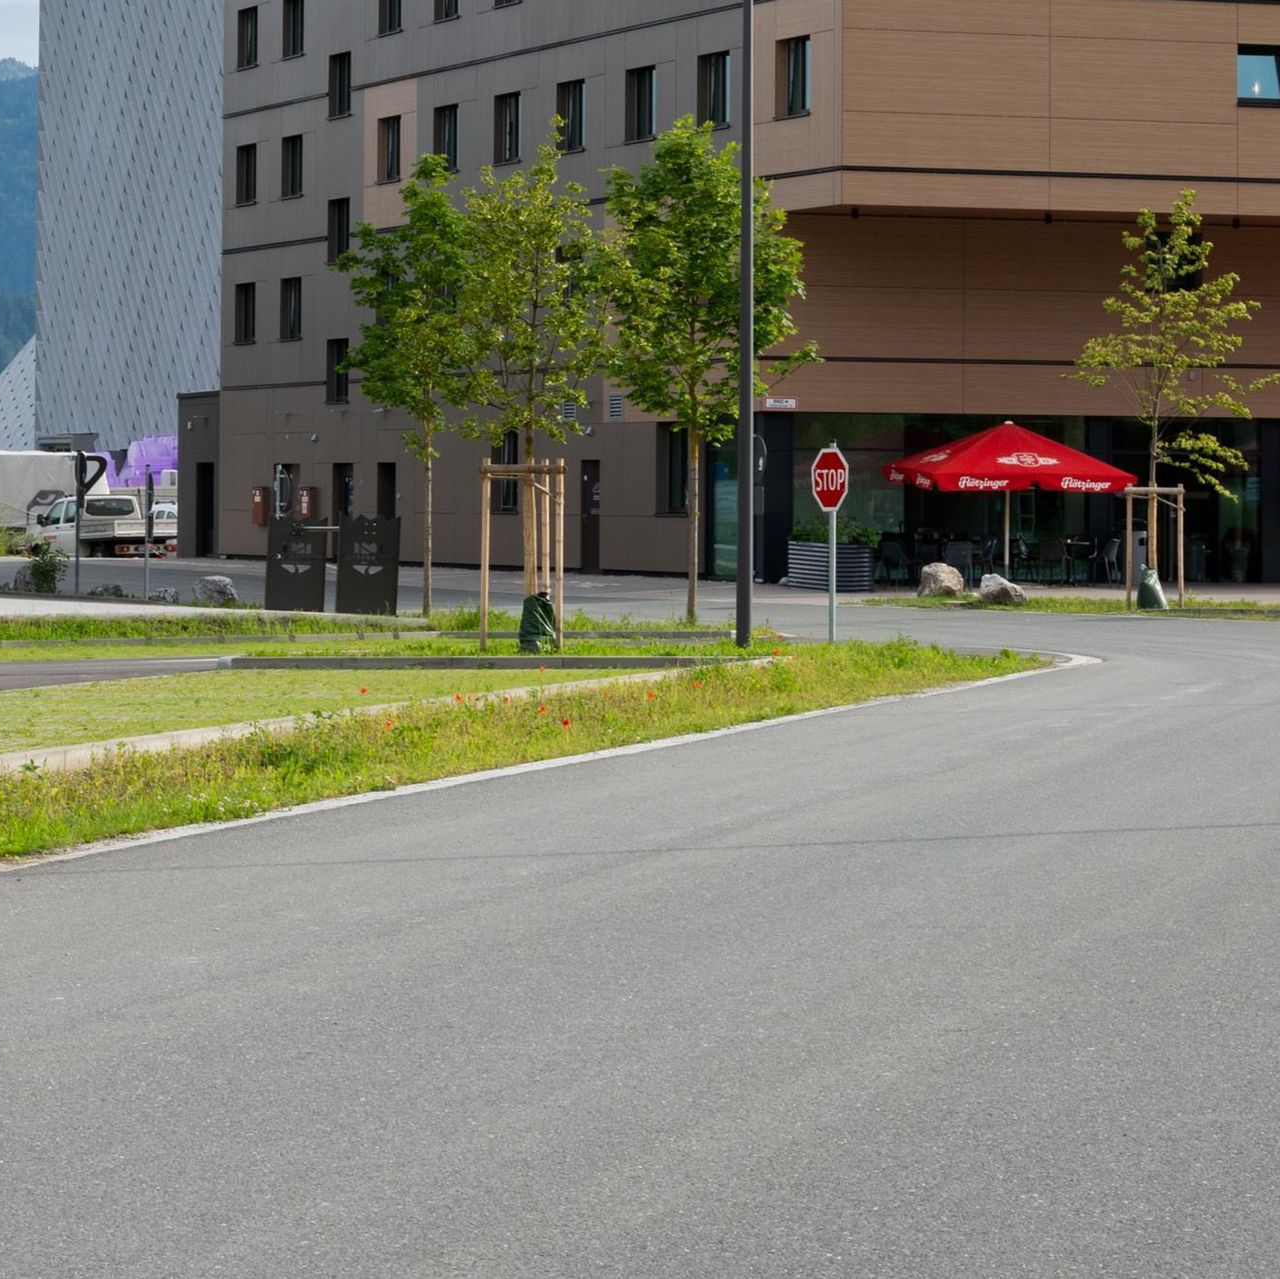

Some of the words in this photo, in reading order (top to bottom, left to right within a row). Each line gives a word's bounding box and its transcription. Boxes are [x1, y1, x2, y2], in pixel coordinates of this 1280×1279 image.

[815, 468, 845, 491] STOP
[958, 476, 1010, 490] Flötzinger
[1061, 476, 1112, 491] Flötzinger
